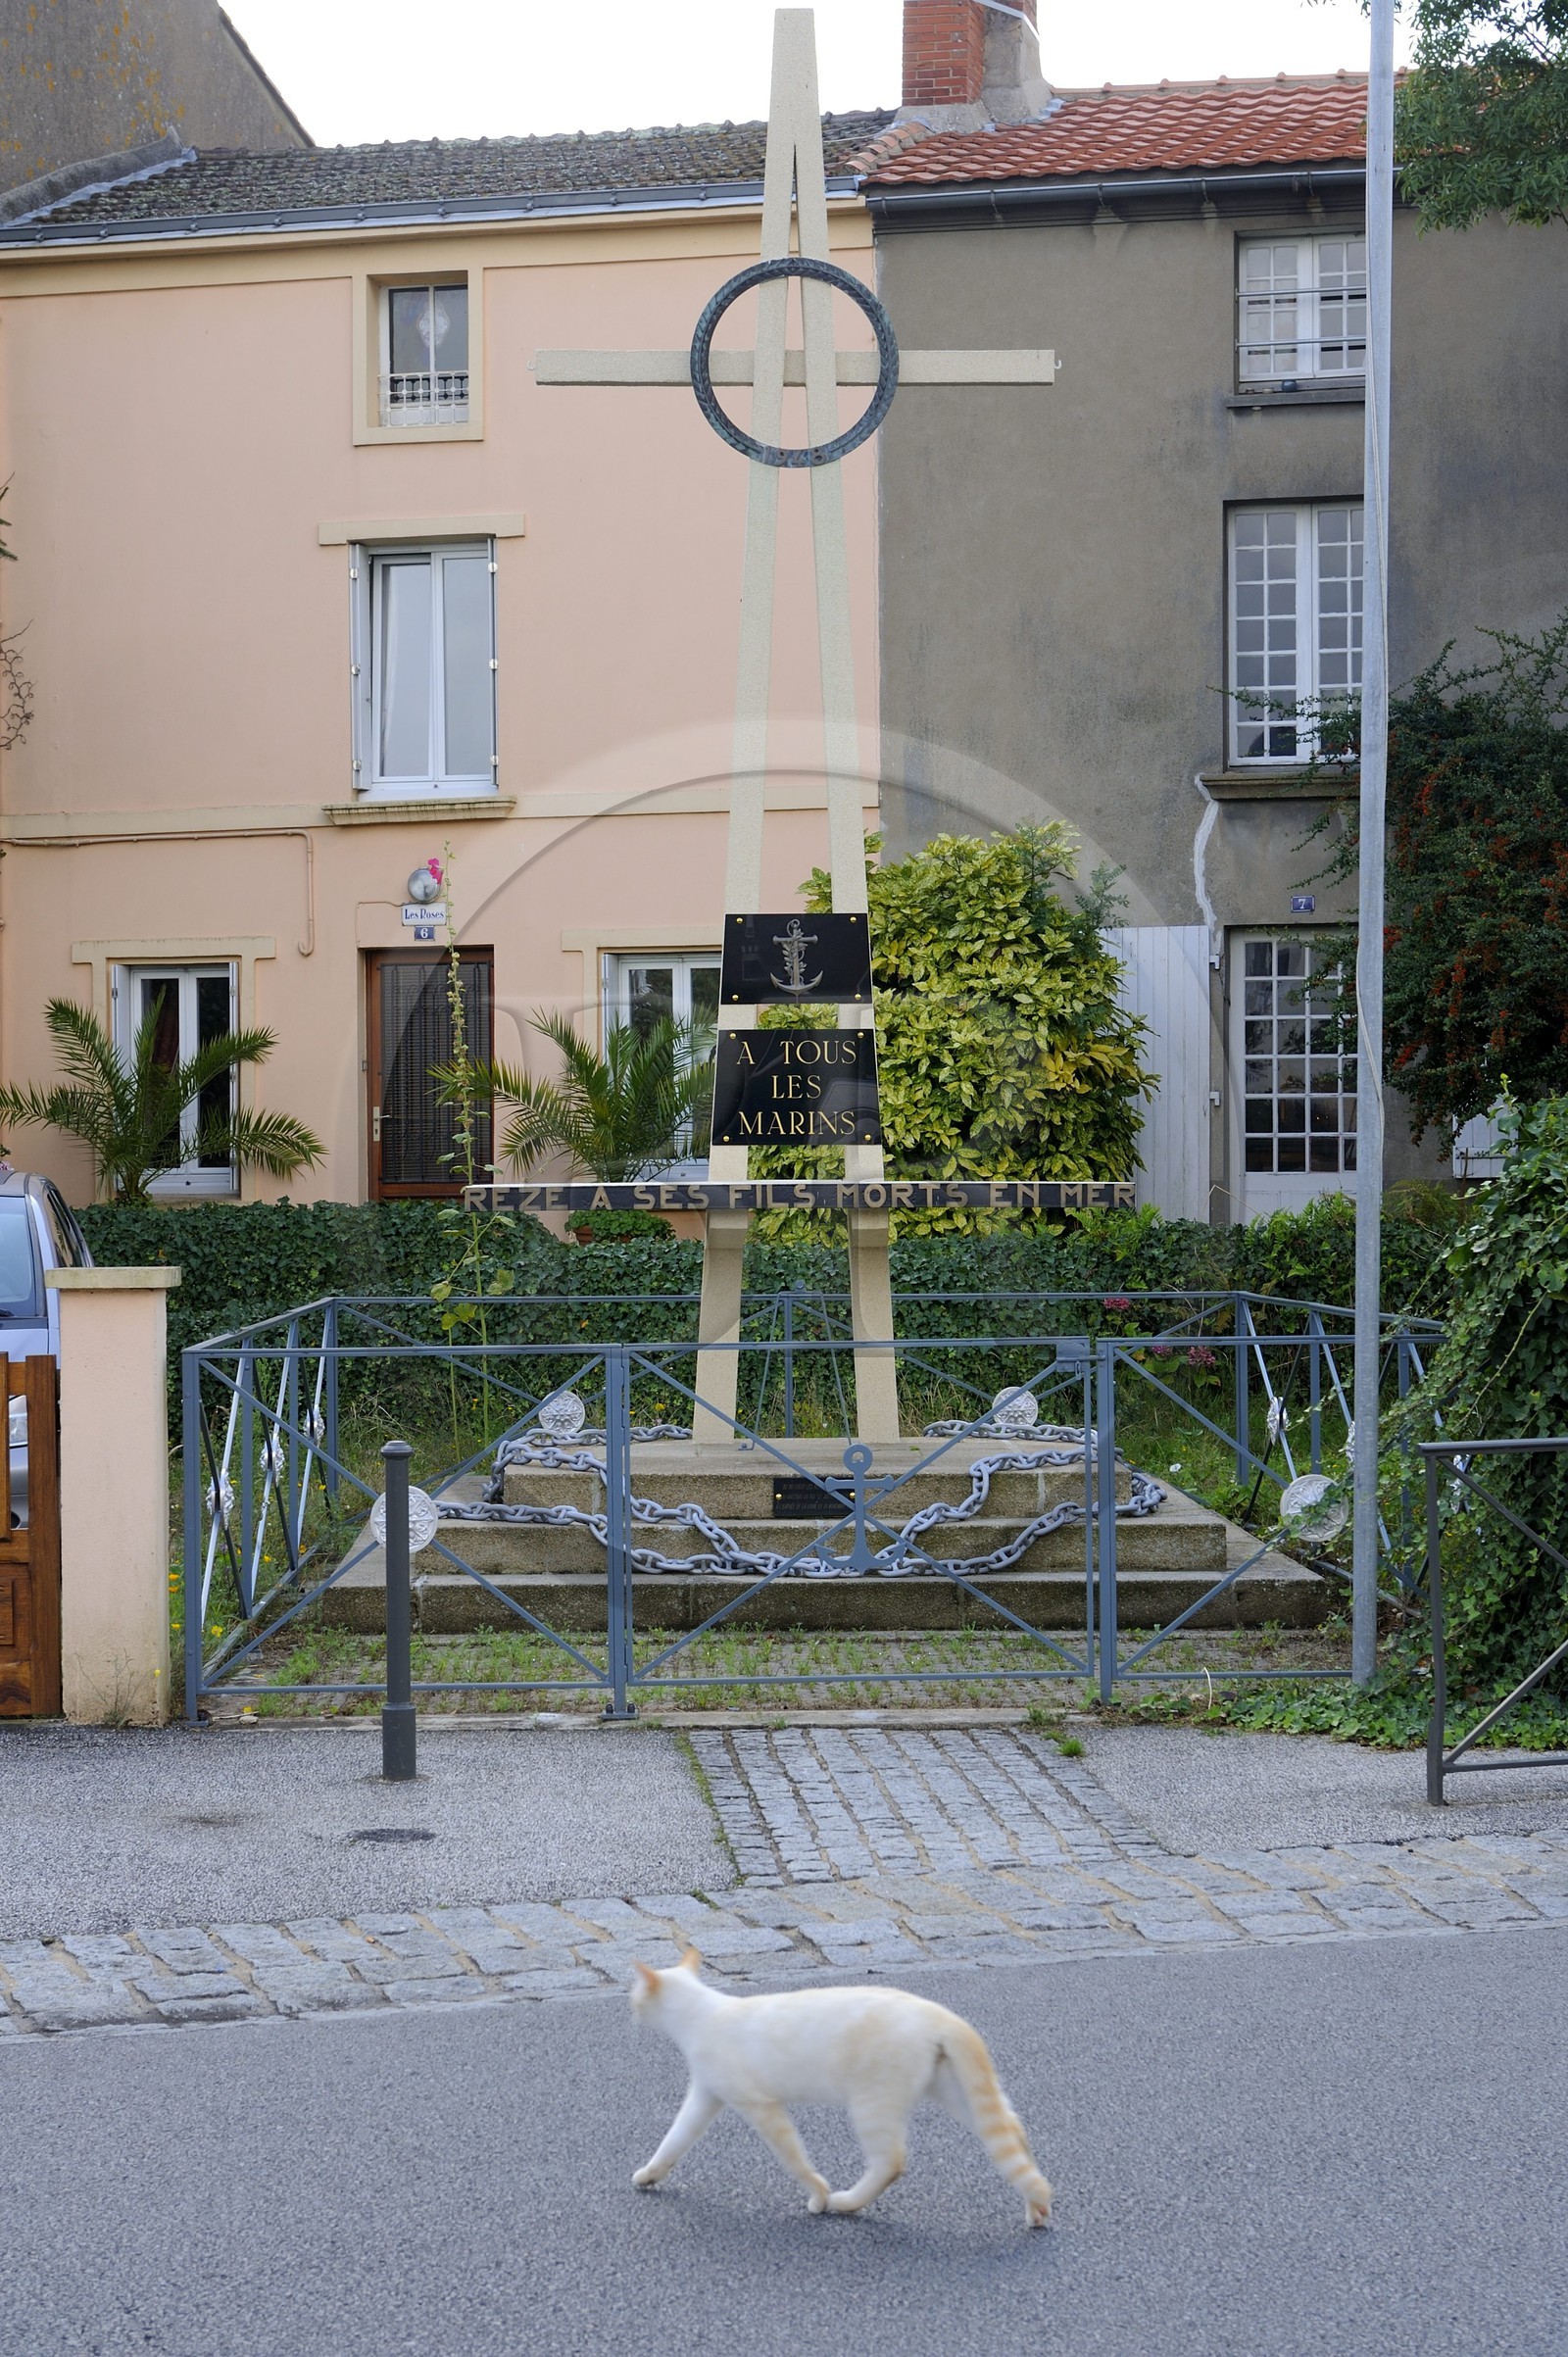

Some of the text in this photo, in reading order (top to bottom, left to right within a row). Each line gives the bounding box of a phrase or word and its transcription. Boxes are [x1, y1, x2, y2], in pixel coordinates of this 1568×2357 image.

[405, 908, 445, 920] Les Roses
[1298, 898, 1307, 909] 7
[419, 926, 429, 939] 6
[736, 1040, 858, 1065] A TOUS
[771, 1074, 821, 1100] LES
[738, 1110, 856, 1136] MARINS
[464, 1183, 1136, 1212] REZE A SES FILS MORTS EN MER
